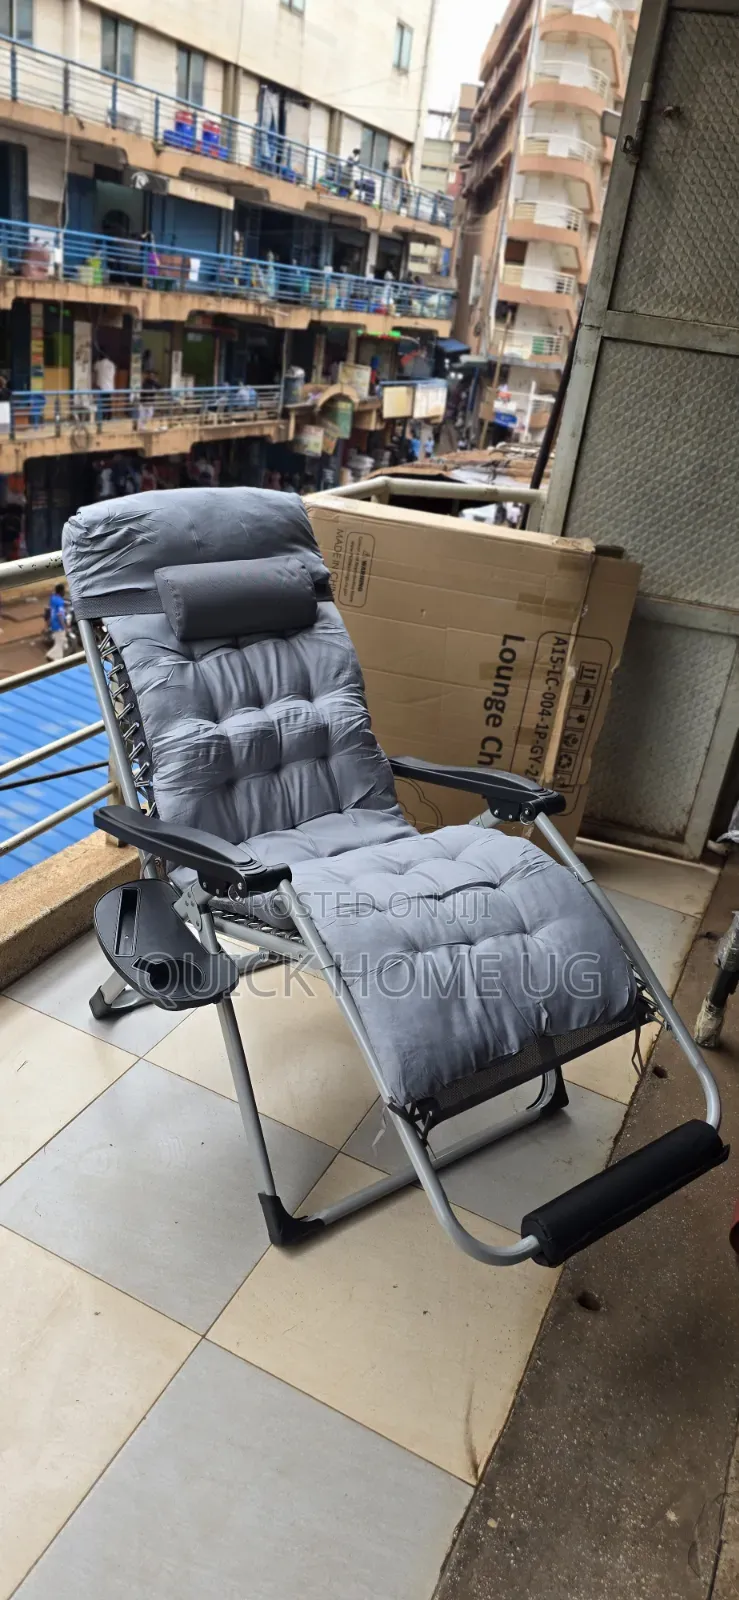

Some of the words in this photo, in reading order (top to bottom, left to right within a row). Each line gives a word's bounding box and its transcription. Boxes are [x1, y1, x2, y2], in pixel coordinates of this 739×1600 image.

[333, 529, 344, 558] MADE
[332, 560, 340, 570] IN
[358, 561, 367, 591] WARNING
[484, 634, 525, 728] Lounge
[477, 736, 503, 766] Ch
